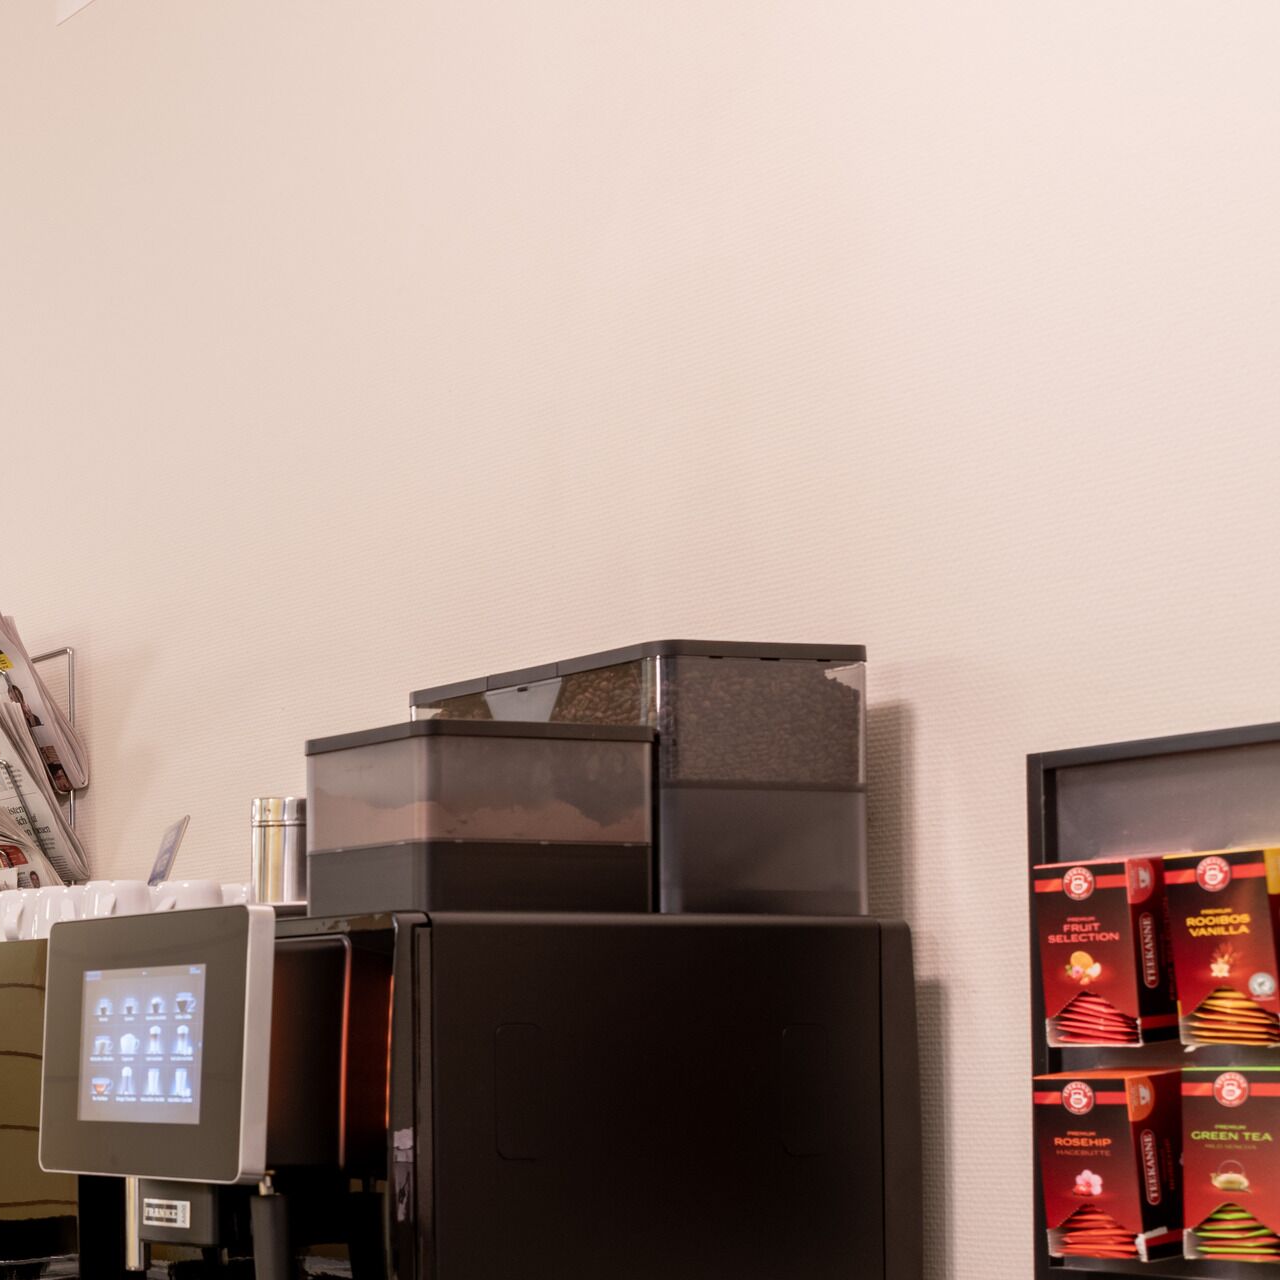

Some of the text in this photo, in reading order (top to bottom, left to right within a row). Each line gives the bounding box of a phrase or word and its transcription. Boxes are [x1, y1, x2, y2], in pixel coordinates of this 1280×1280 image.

[1185, 913, 1251, 927] ROOIBOS
[1063, 922, 1101, 932] FRUIT
[1188, 924, 1251, 937] VANILLA
[1047, 932, 1120, 944] SELECTION
[1142, 917, 1156, 982] TEEKANNE
[1054, 1137, 1112, 1147] ROSEHIP
[1191, 1131, 1273, 1142] GREEN TEA
[1143, 1134, 1158, 1198] TEEKANNE
